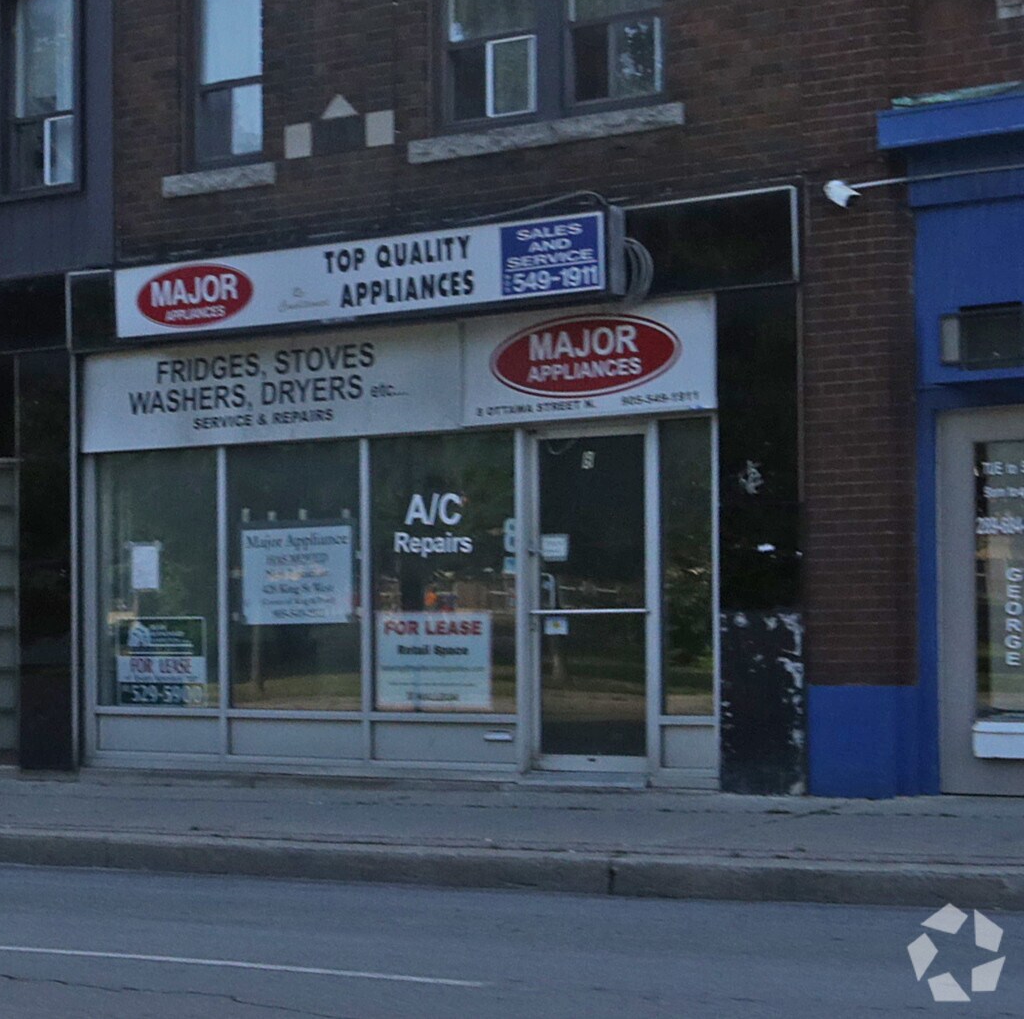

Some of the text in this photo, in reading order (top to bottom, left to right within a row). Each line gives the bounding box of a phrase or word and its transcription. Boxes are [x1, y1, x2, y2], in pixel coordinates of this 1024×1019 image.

[516, 222, 583, 241] SALES
[324, 235, 470, 274] TOP QUALITY
[506, 247, 595, 269] SERVICE
[528, 237, 572, 253] AND
[150, 272, 239, 308] MAJOR
[340, 269, 474, 308] APPLIANCES
[512, 264, 599, 293] 549-1911
[164, 305, 226, 322] APPLIANCES
[528, 324, 638, 362] MAJOR
[156, 342, 376, 384] FRIDGES, STOVES
[527, 356, 643, 383] APPLIANCES
[128, 383, 253, 415] WASHERS,
[261, 375, 364, 406] DRYERS
[192, 408, 334, 431] SERVICE & REPAIRS
[486, 404, 533, 417] OTTAWA
[536, 400, 580, 413] STREET
[404, 492, 463, 526] A/C
[394, 531, 474, 557] Repairs
[383, 620, 482, 635] FOR LEASE
[130, 657, 153, 674] FOR
